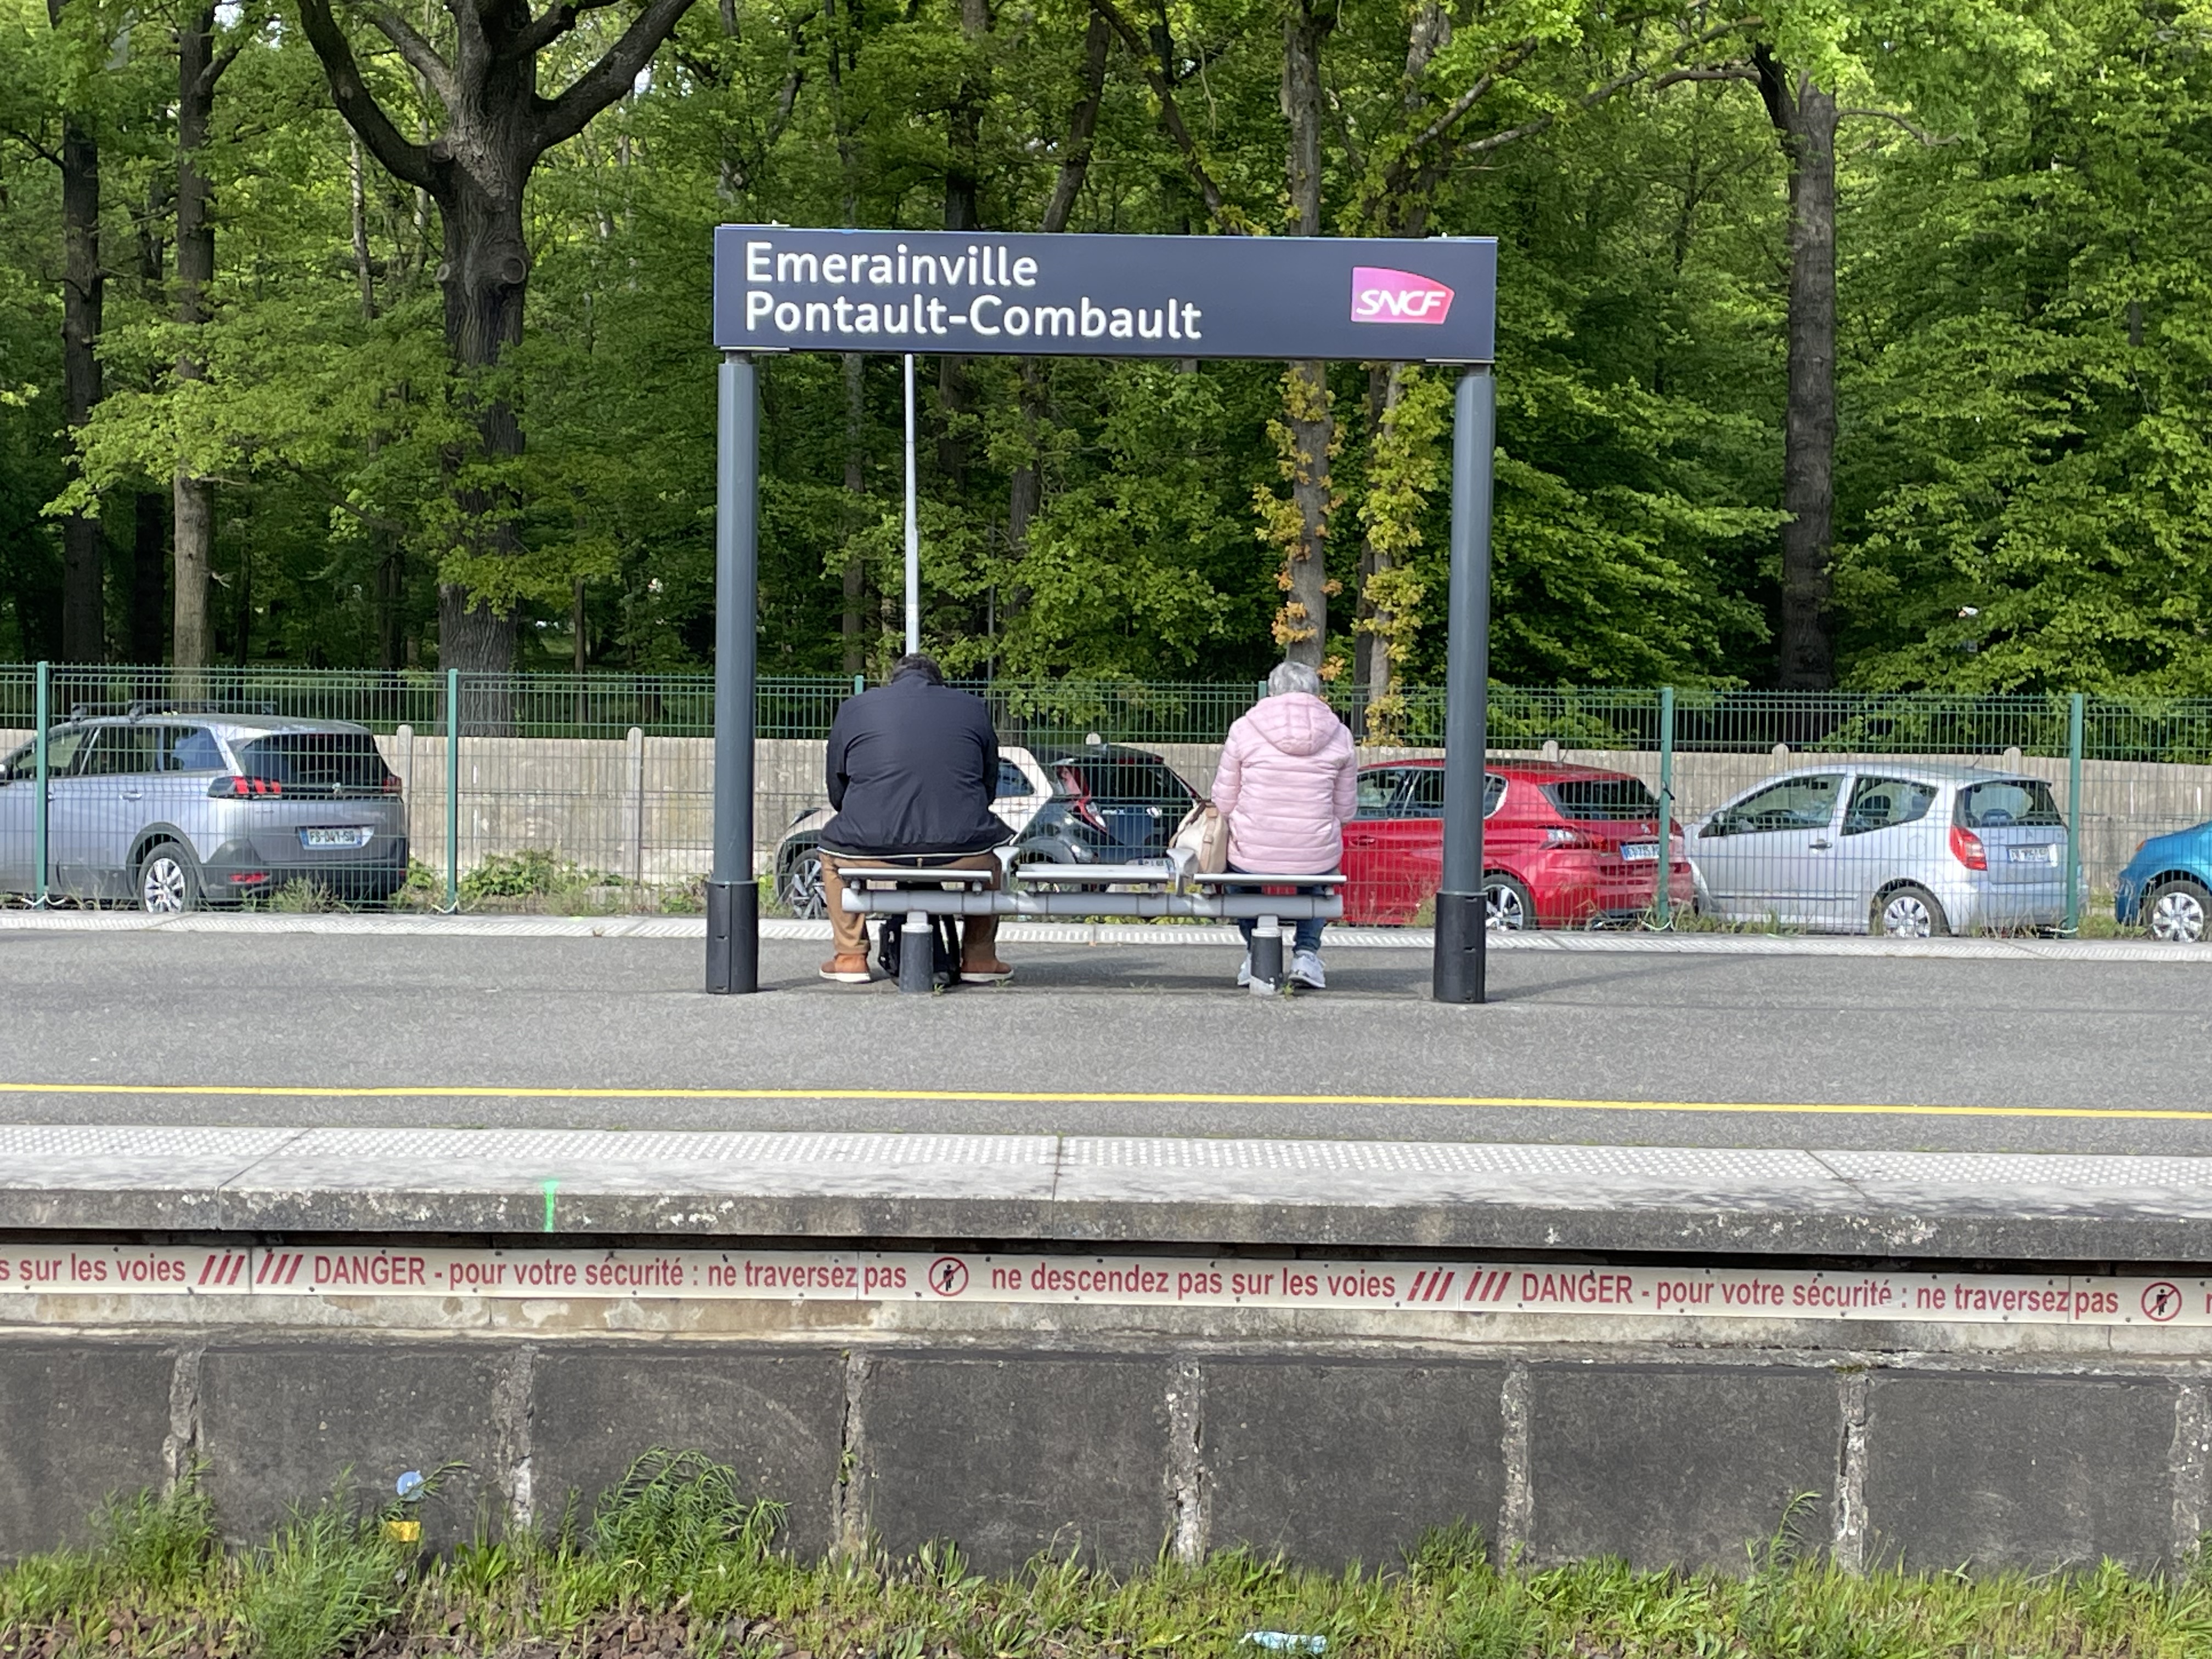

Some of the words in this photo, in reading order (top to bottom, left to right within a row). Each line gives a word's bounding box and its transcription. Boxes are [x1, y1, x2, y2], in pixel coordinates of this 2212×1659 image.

[746, 240, 1039, 288] Emerainville
[746, 289, 1202, 340] Pontault-Combault
[1356, 290, 1446, 317] SNCF
[20, 1260, 61, 1280] sur
[71, 1254, 106, 1281] les
[116, 1254, 185, 1282] voies
[314, 1255, 425, 1285] DANGER
[449, 1262, 506, 1290] pour
[514, 1260, 576, 1285] votre
[585, 1257, 683, 1286] sécurité
[708, 1265, 736, 1287] ne
[744, 1261, 857, 1288] traversez
[864, 1267, 907, 1295] pas
[992, 1268, 1022, 1290] ne
[1030, 1262, 1169, 1293] descendez
[1177, 1272, 1222, 1299] pas
[1231, 1273, 1273, 1295] sur
[1282, 1268, 1318, 1296] les
[1327, 1269, 1396, 1298] voies
[1522, 1273, 1633, 1304] DANGER
[1656, 1281, 1713, 1309] pour
[1721, 1279, 1784, 1306] votre
[1792, 1278, 1891, 1307] sécurité
[1916, 1288, 1945, 1309] ne
[1954, 1285, 2069, 1312] traversez
[2074, 1291, 2118, 1319] pas
